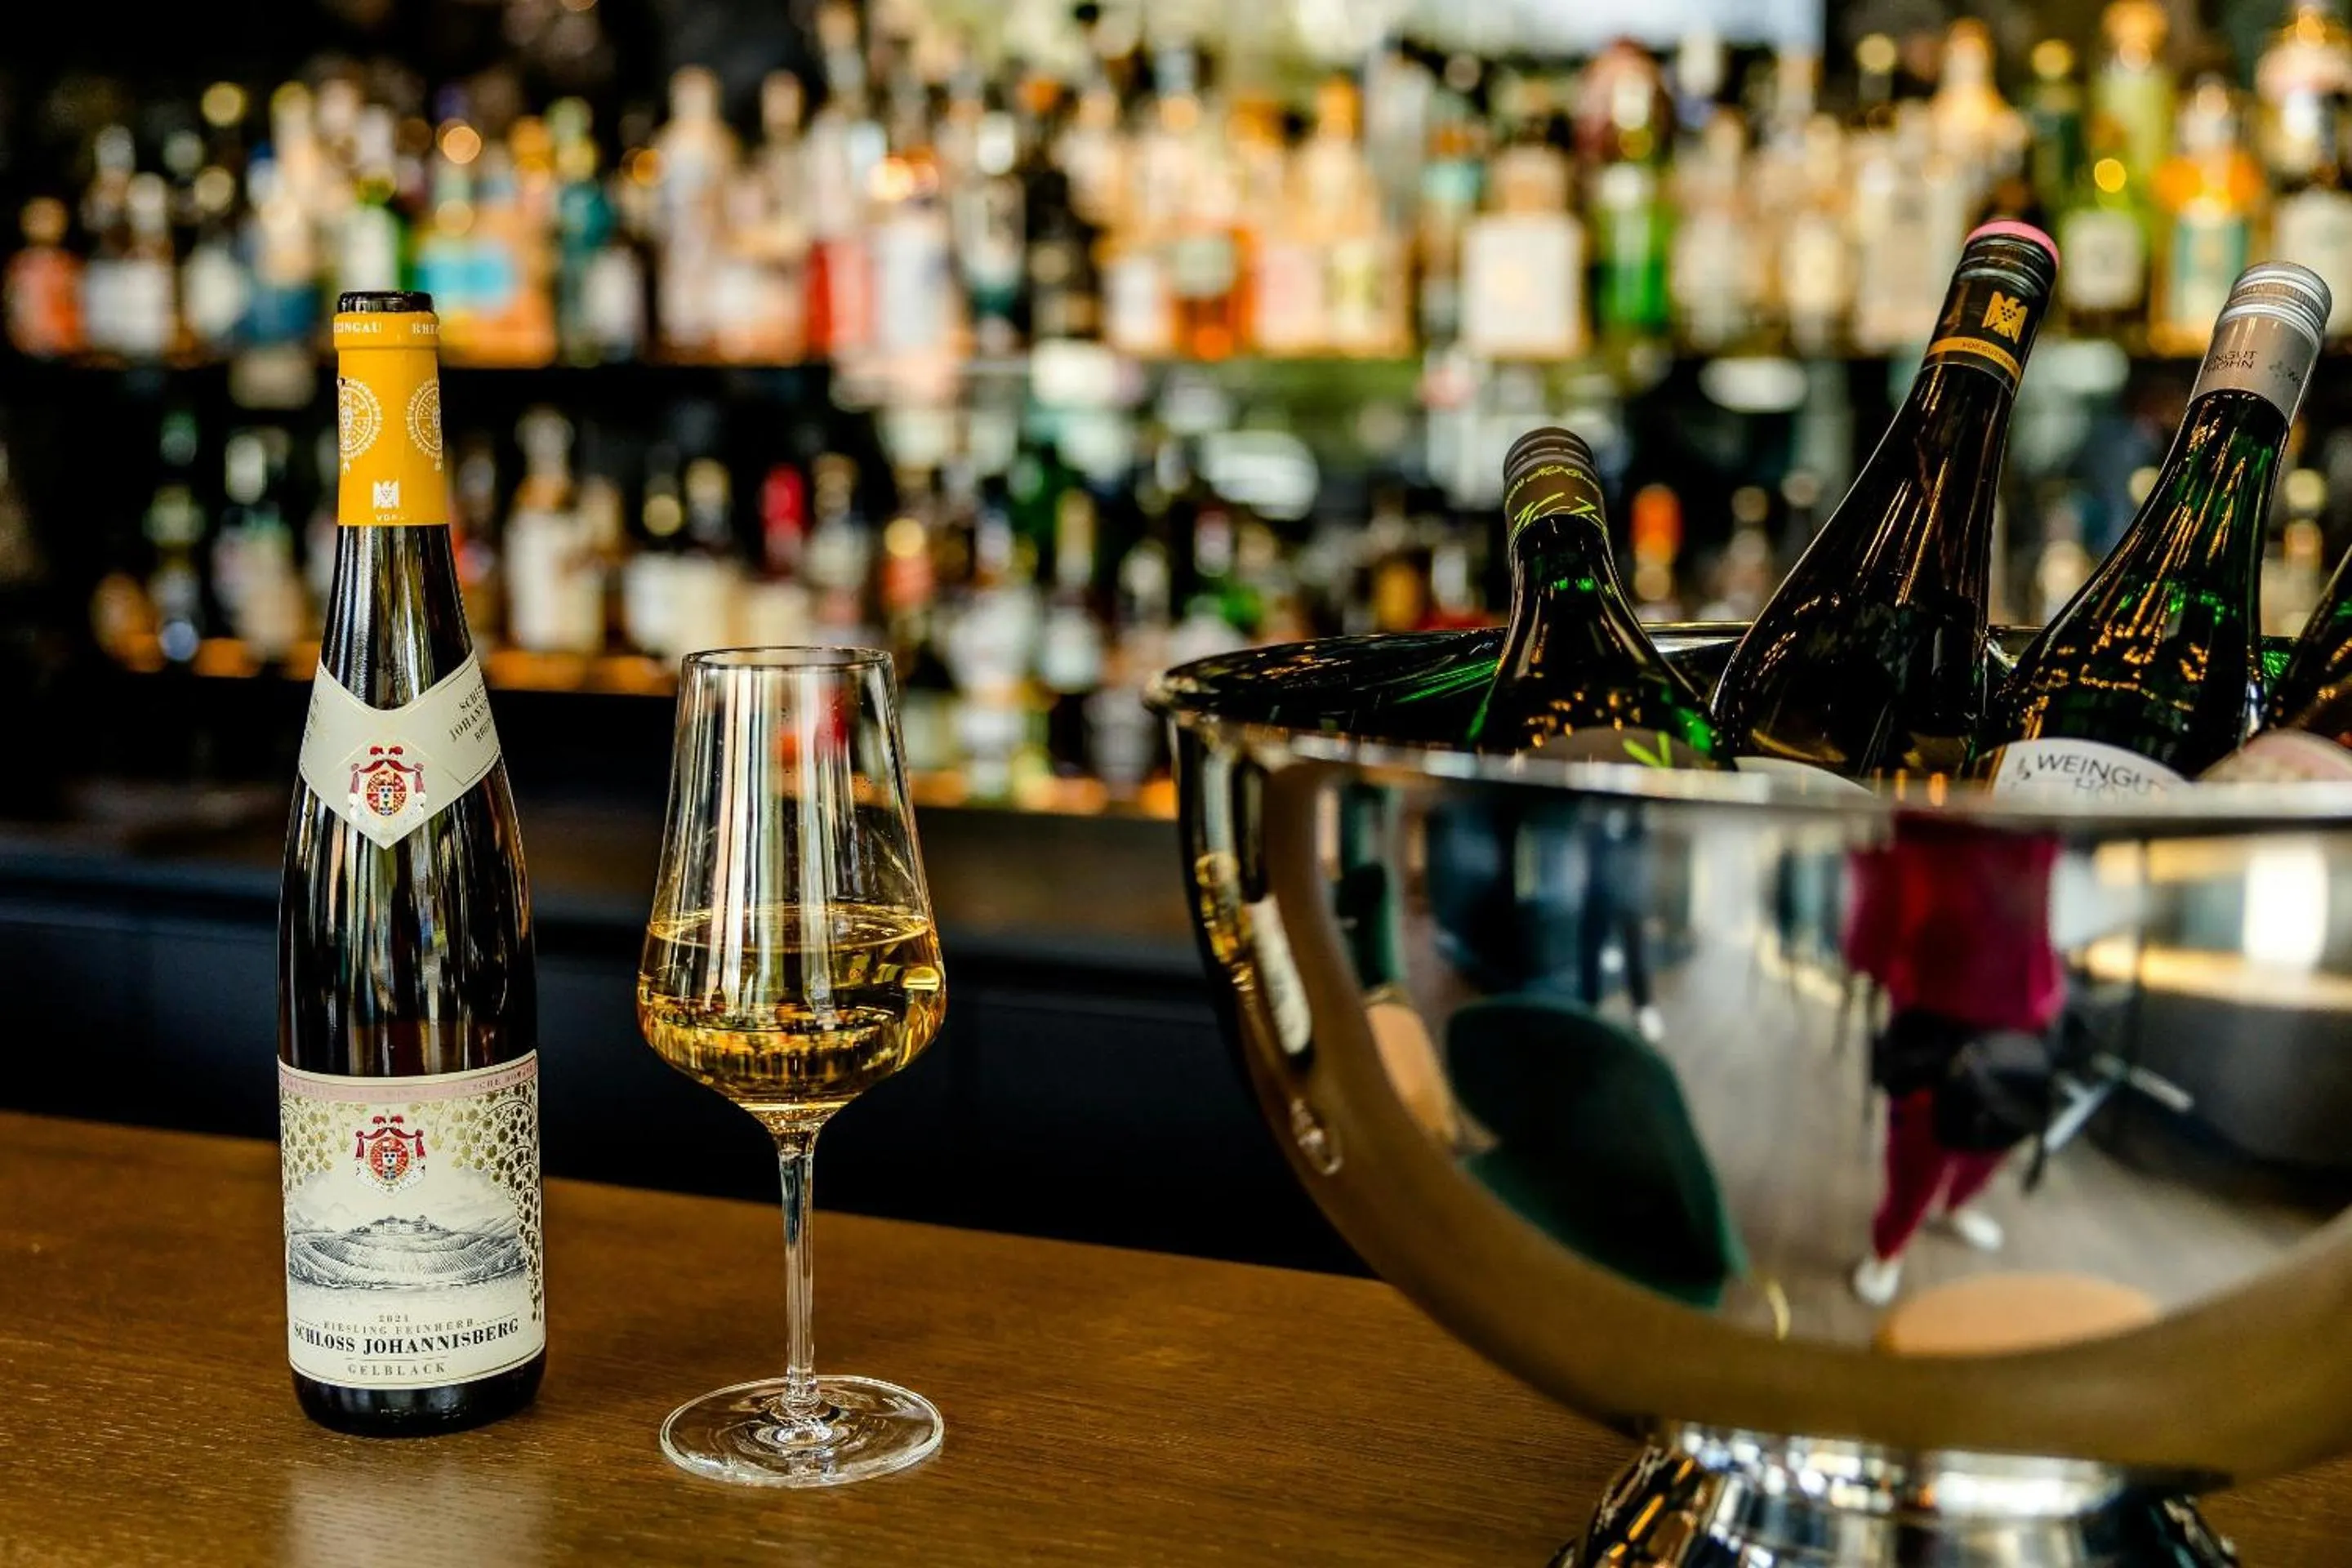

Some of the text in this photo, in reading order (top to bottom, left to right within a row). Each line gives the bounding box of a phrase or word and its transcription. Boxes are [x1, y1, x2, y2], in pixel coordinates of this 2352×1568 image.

[378, 1314, 408, 1323] 2021
[323, 1318, 473, 1335] RIESLING FEINHERB
[294, 1317, 519, 1355] SCHLOSS JOHANNISBERG
[347, 1362, 445, 1376] GELBLACK
